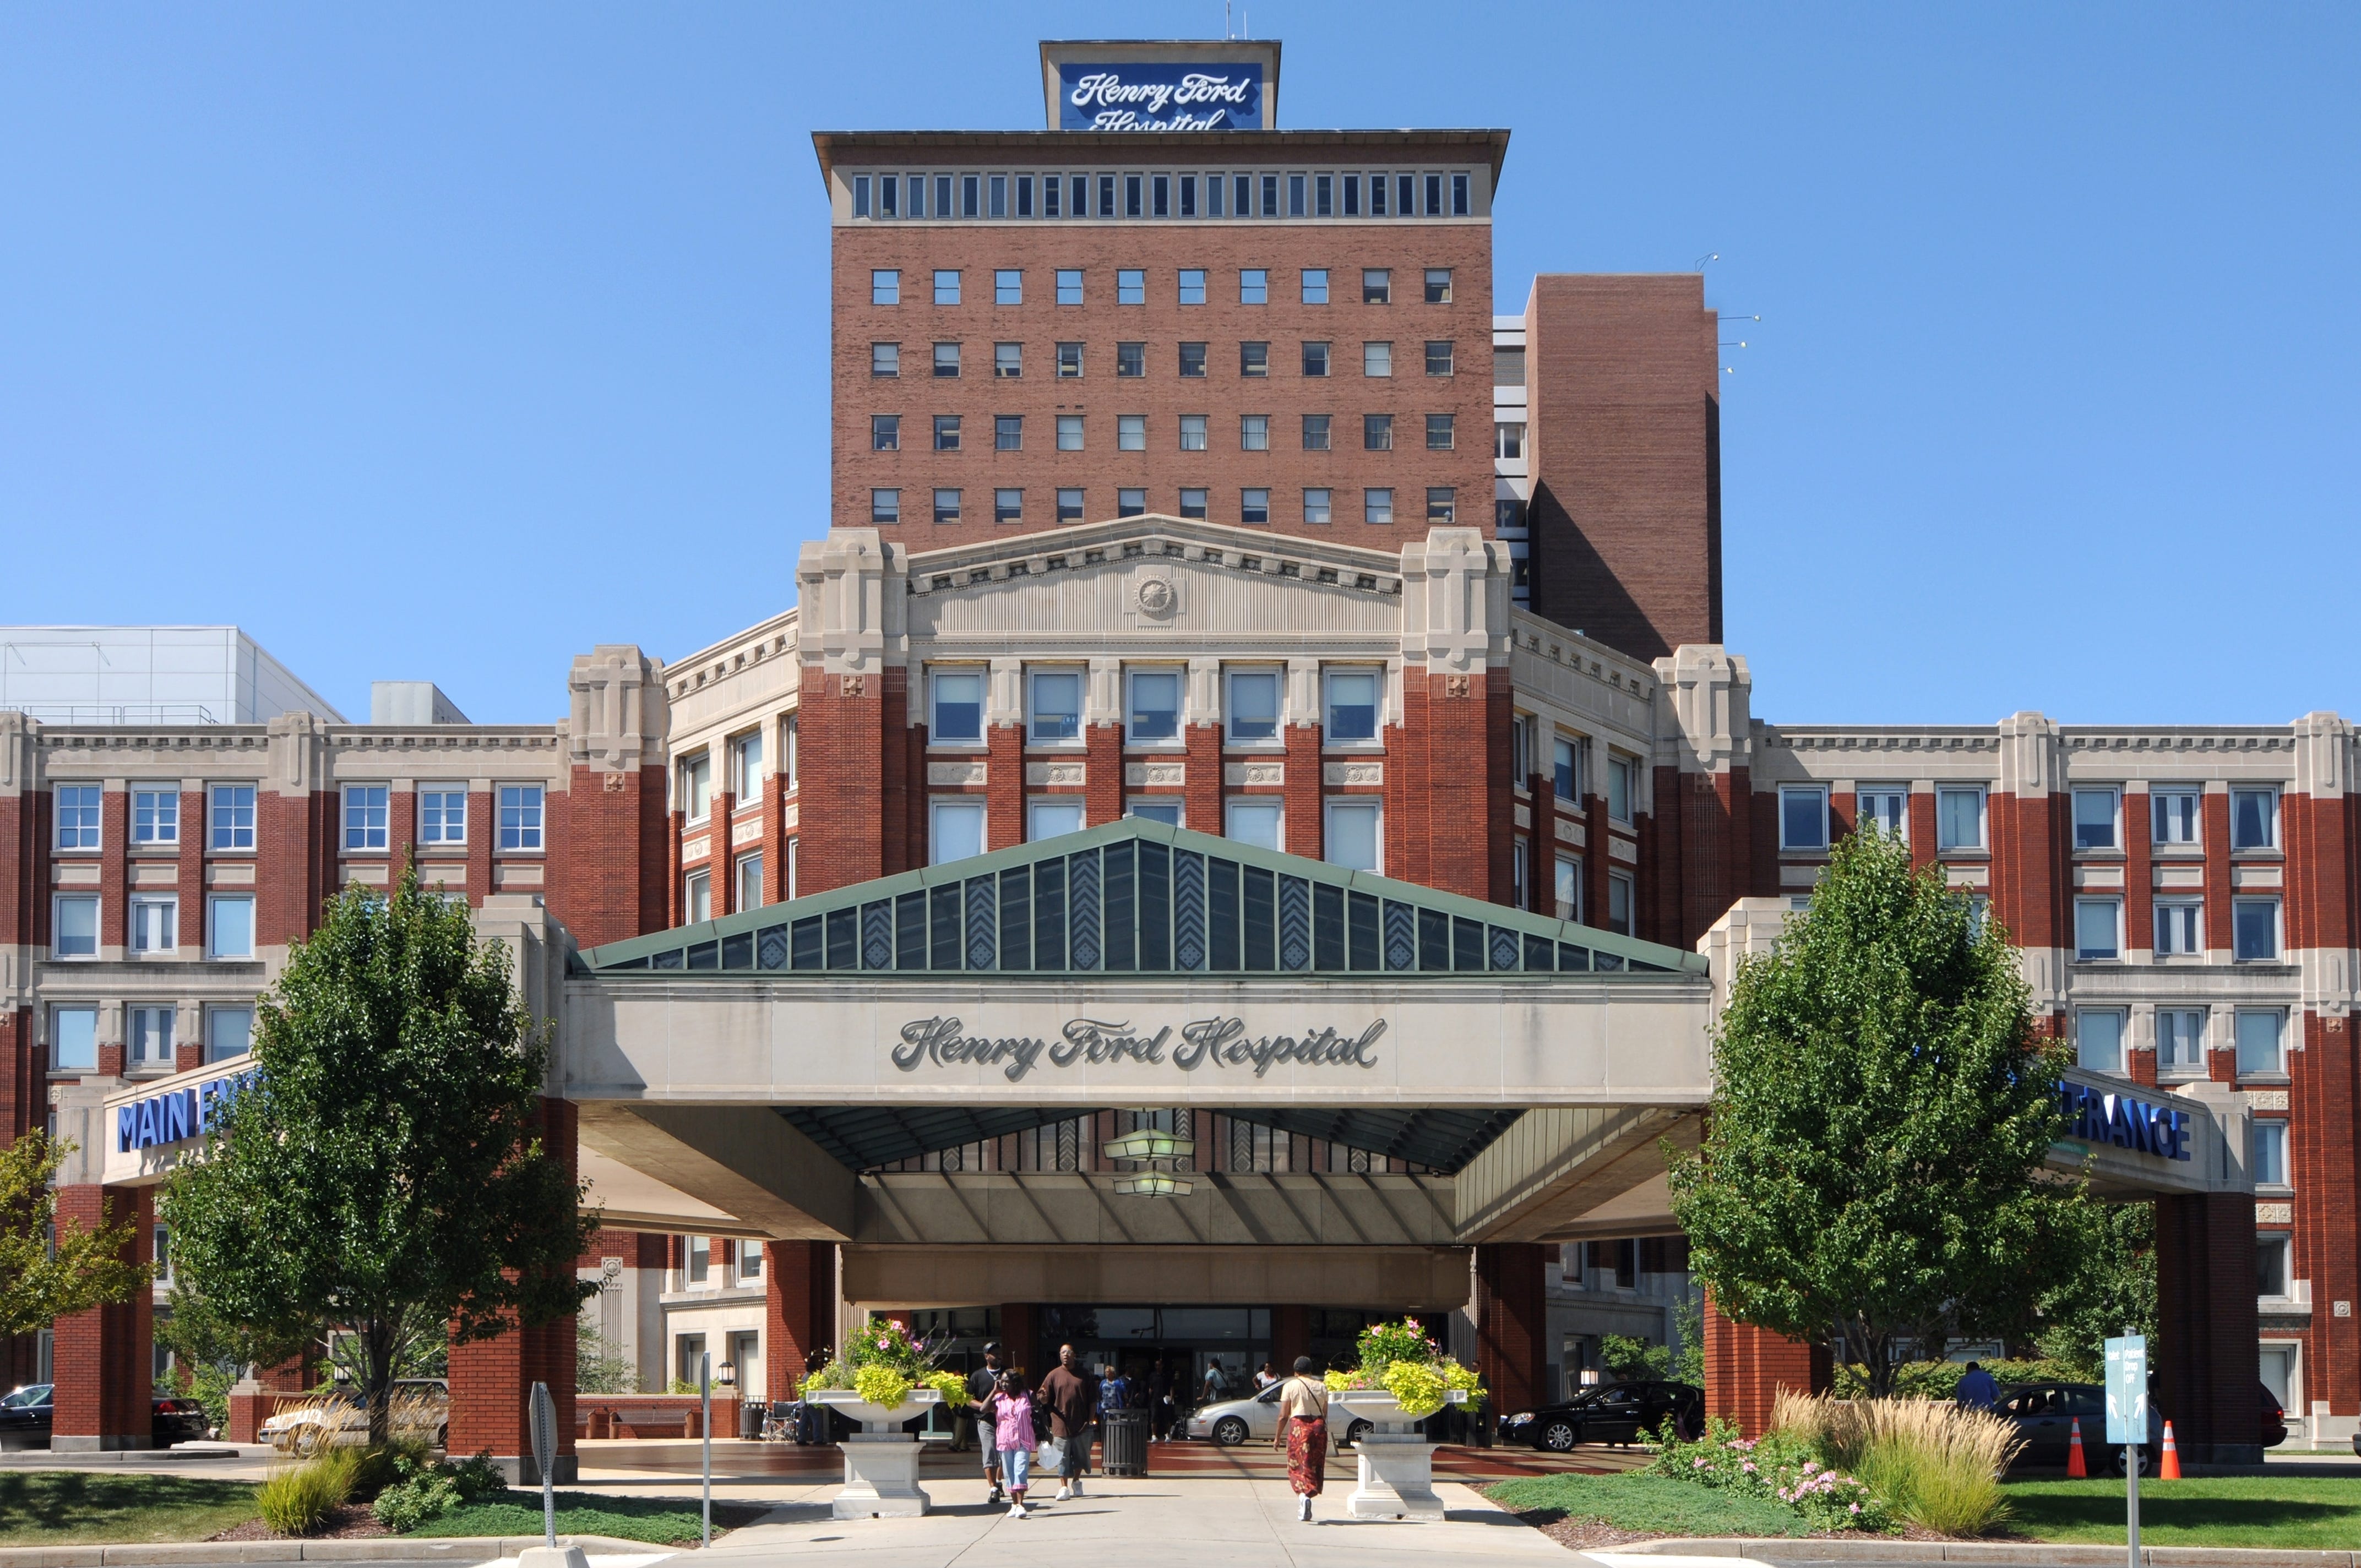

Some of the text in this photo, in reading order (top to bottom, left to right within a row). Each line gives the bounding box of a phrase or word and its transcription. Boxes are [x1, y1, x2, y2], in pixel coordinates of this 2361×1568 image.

[1071, 73, 1251, 113] Henry Ford
[891, 1016, 1385, 1081] Henry Ford Hospital
[117, 1087, 192, 1153] MAIN
[2059, 1081, 2190, 1161] TRANCE
[2107, 1351, 2120, 1361] Valet
[2125, 1348, 2144, 1359] Patient
[2125, 1361, 2138, 1372] Drop
[2125, 1374, 2136, 1384] Off
